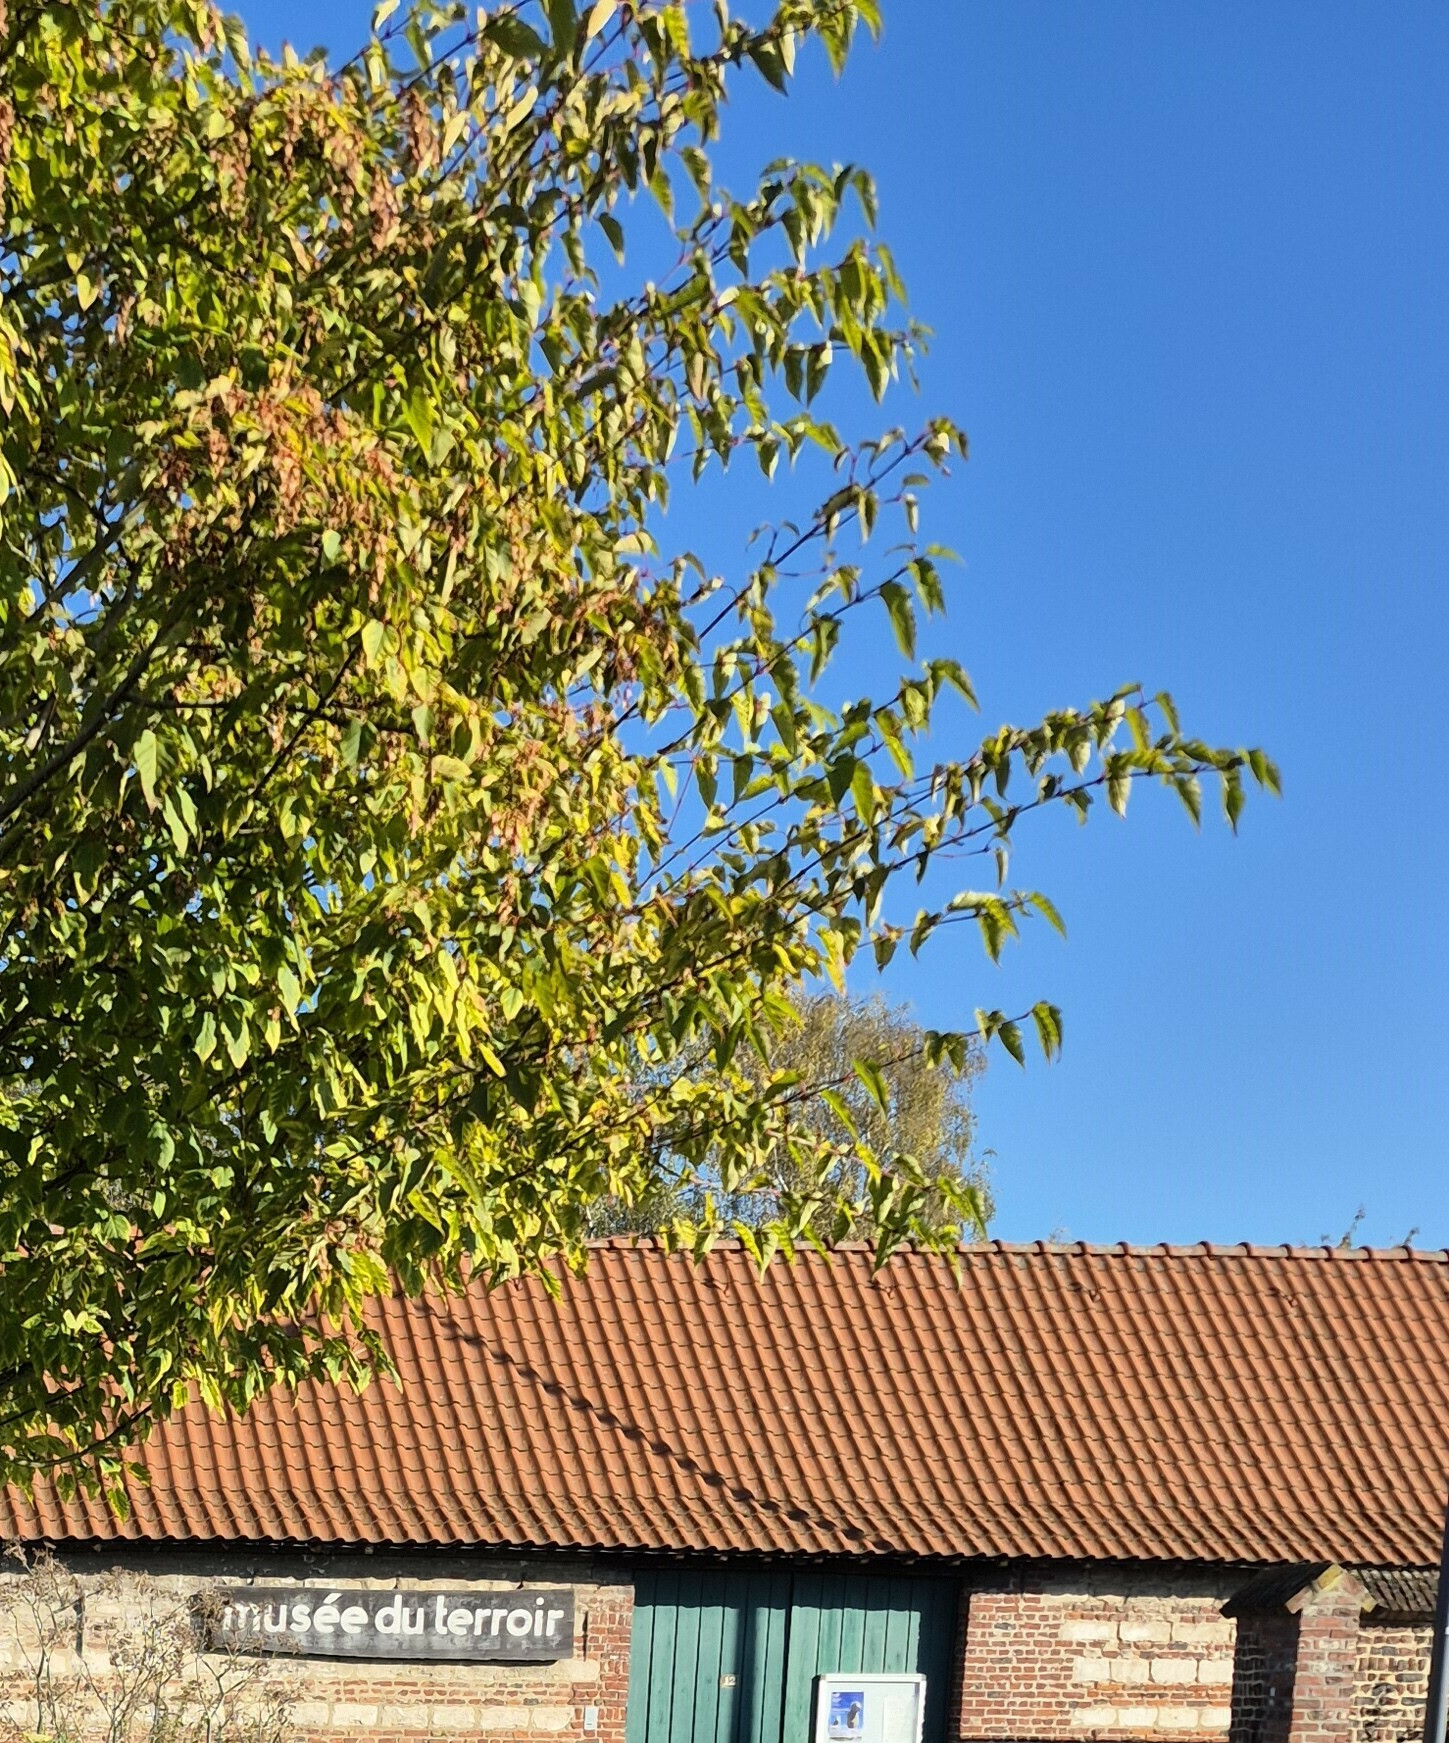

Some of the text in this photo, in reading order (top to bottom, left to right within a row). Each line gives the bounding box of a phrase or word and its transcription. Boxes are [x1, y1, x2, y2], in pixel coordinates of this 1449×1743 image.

[223, 1592, 565, 1637] musée du terroir
[723, 1675, 737, 1687] 12
